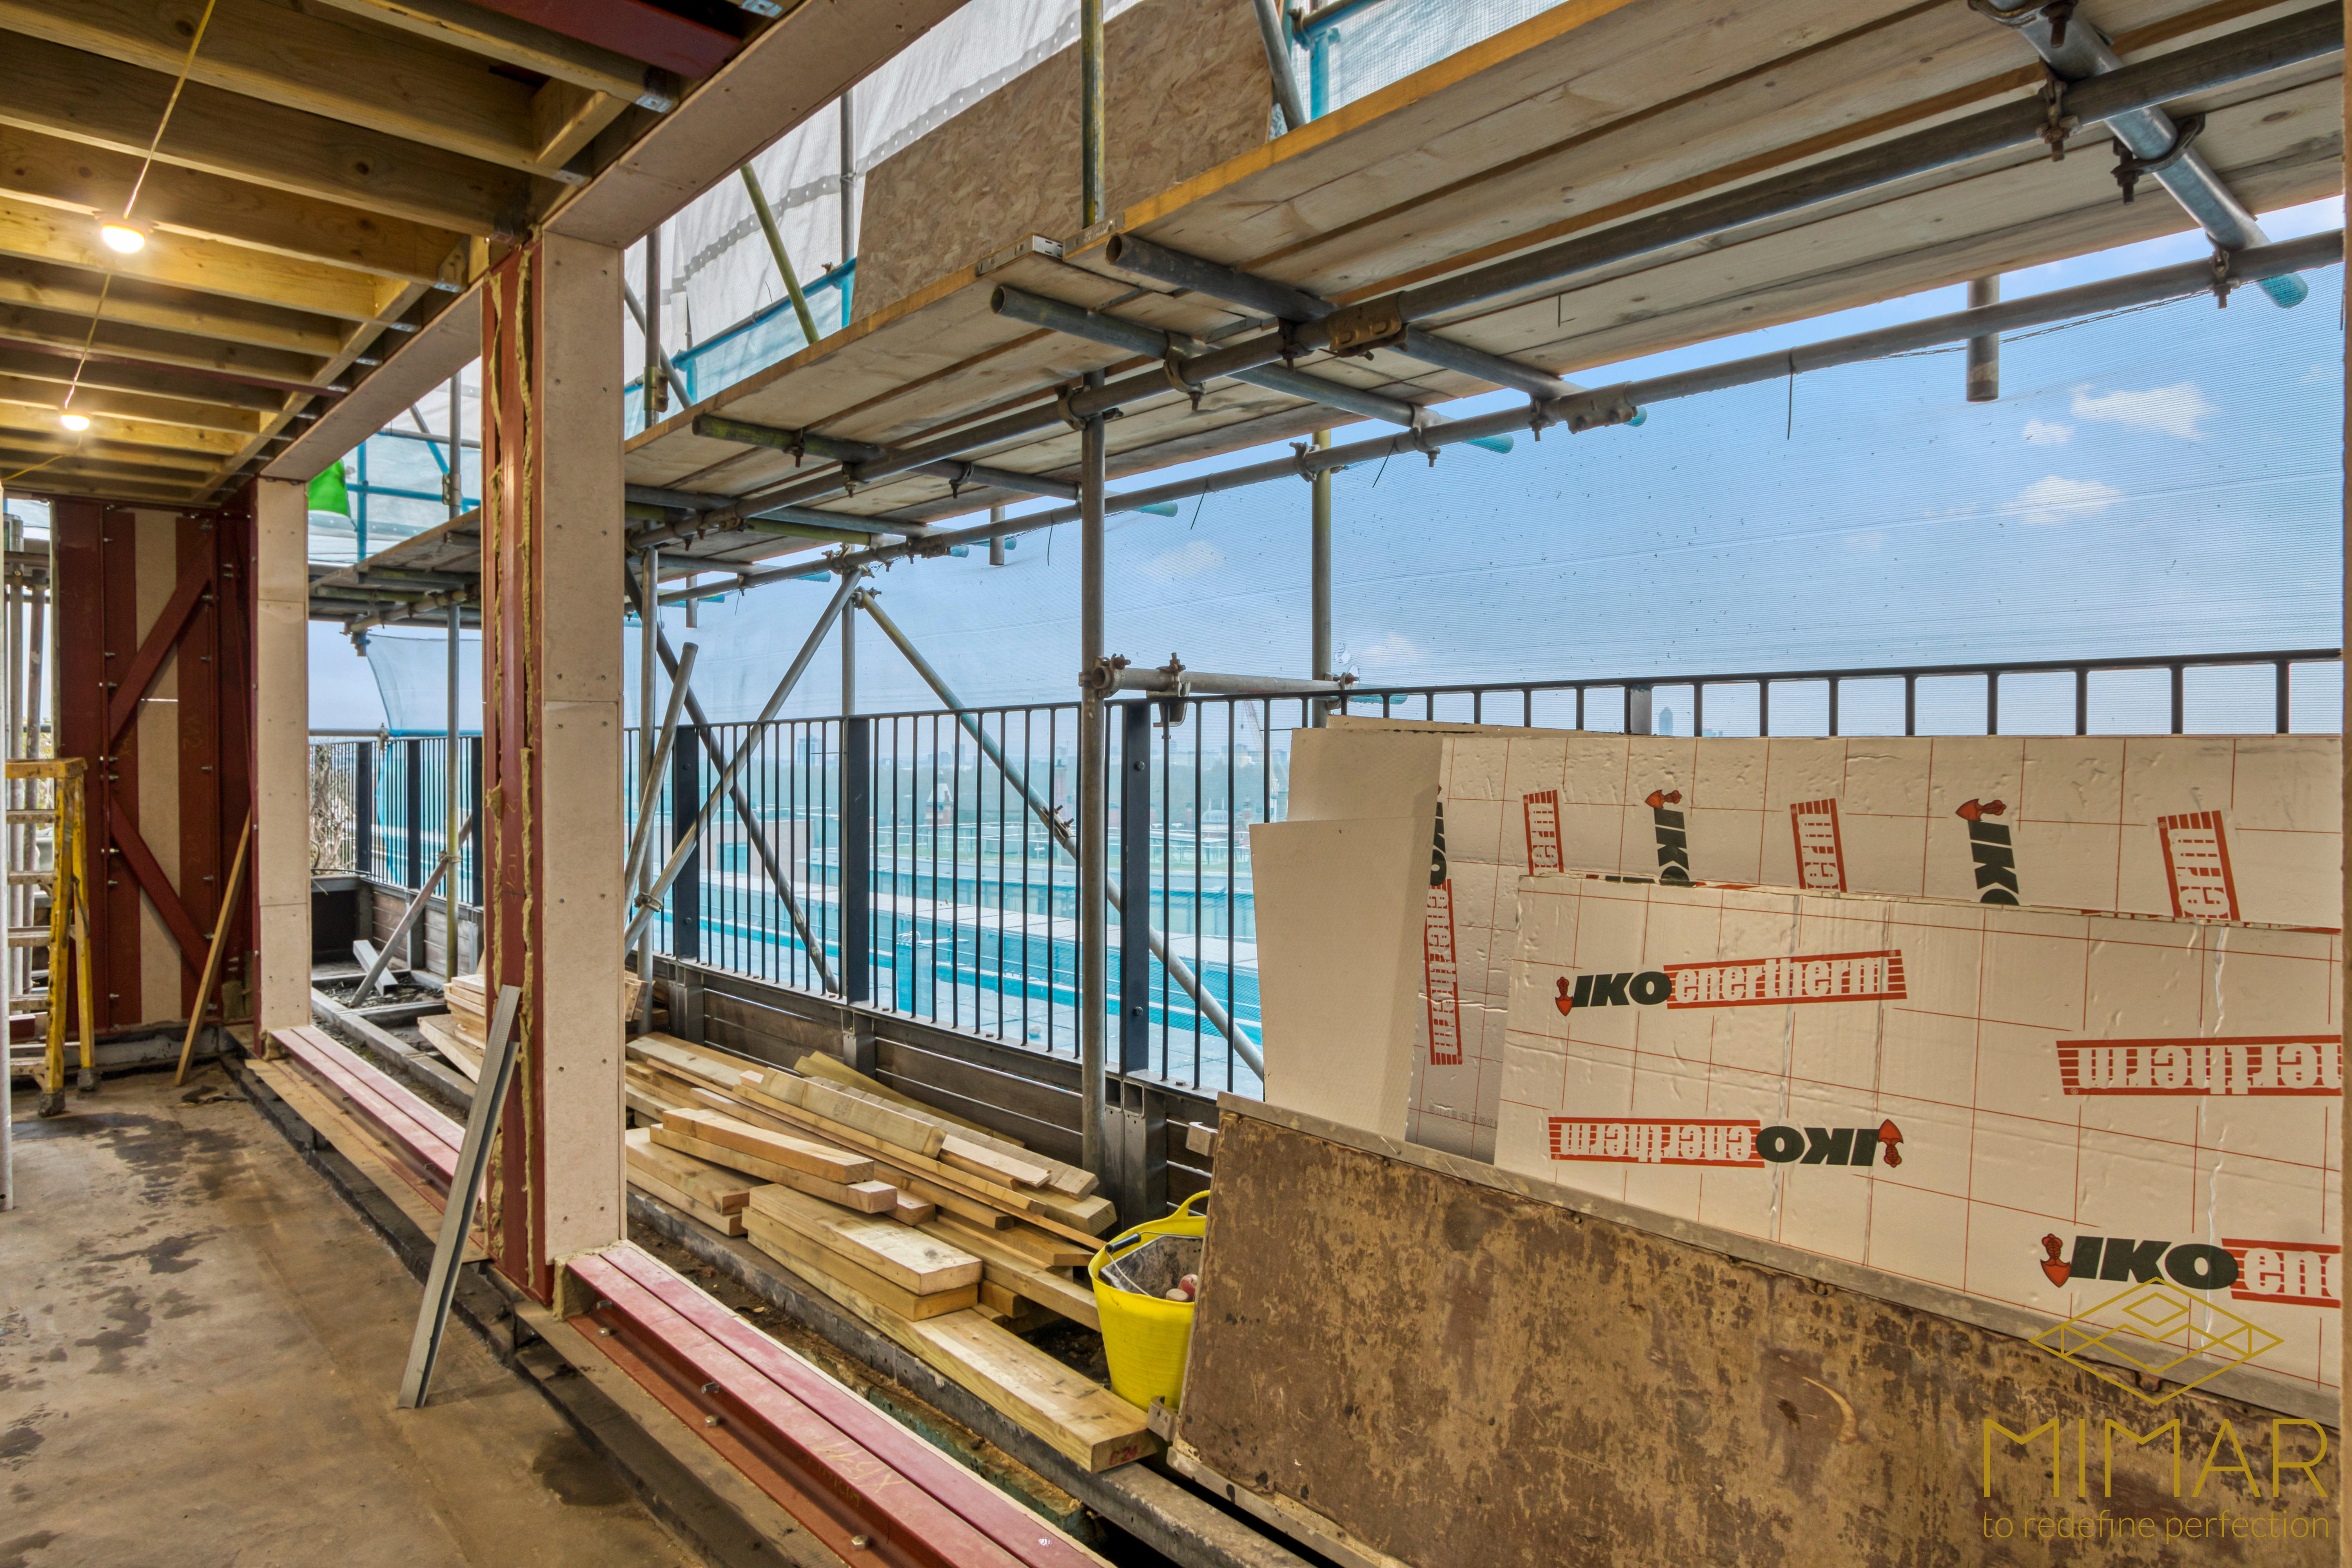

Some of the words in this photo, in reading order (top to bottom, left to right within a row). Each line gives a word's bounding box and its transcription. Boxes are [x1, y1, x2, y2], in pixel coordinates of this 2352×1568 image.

[1573, 971, 1673, 1008] IKO
[1674, 956, 1889, 1004] enertherm
[1559, 1122, 1754, 1163] enertherm
[1755, 1125, 1882, 1167] IKO
[2069, 1235, 2239, 1290] IKO
